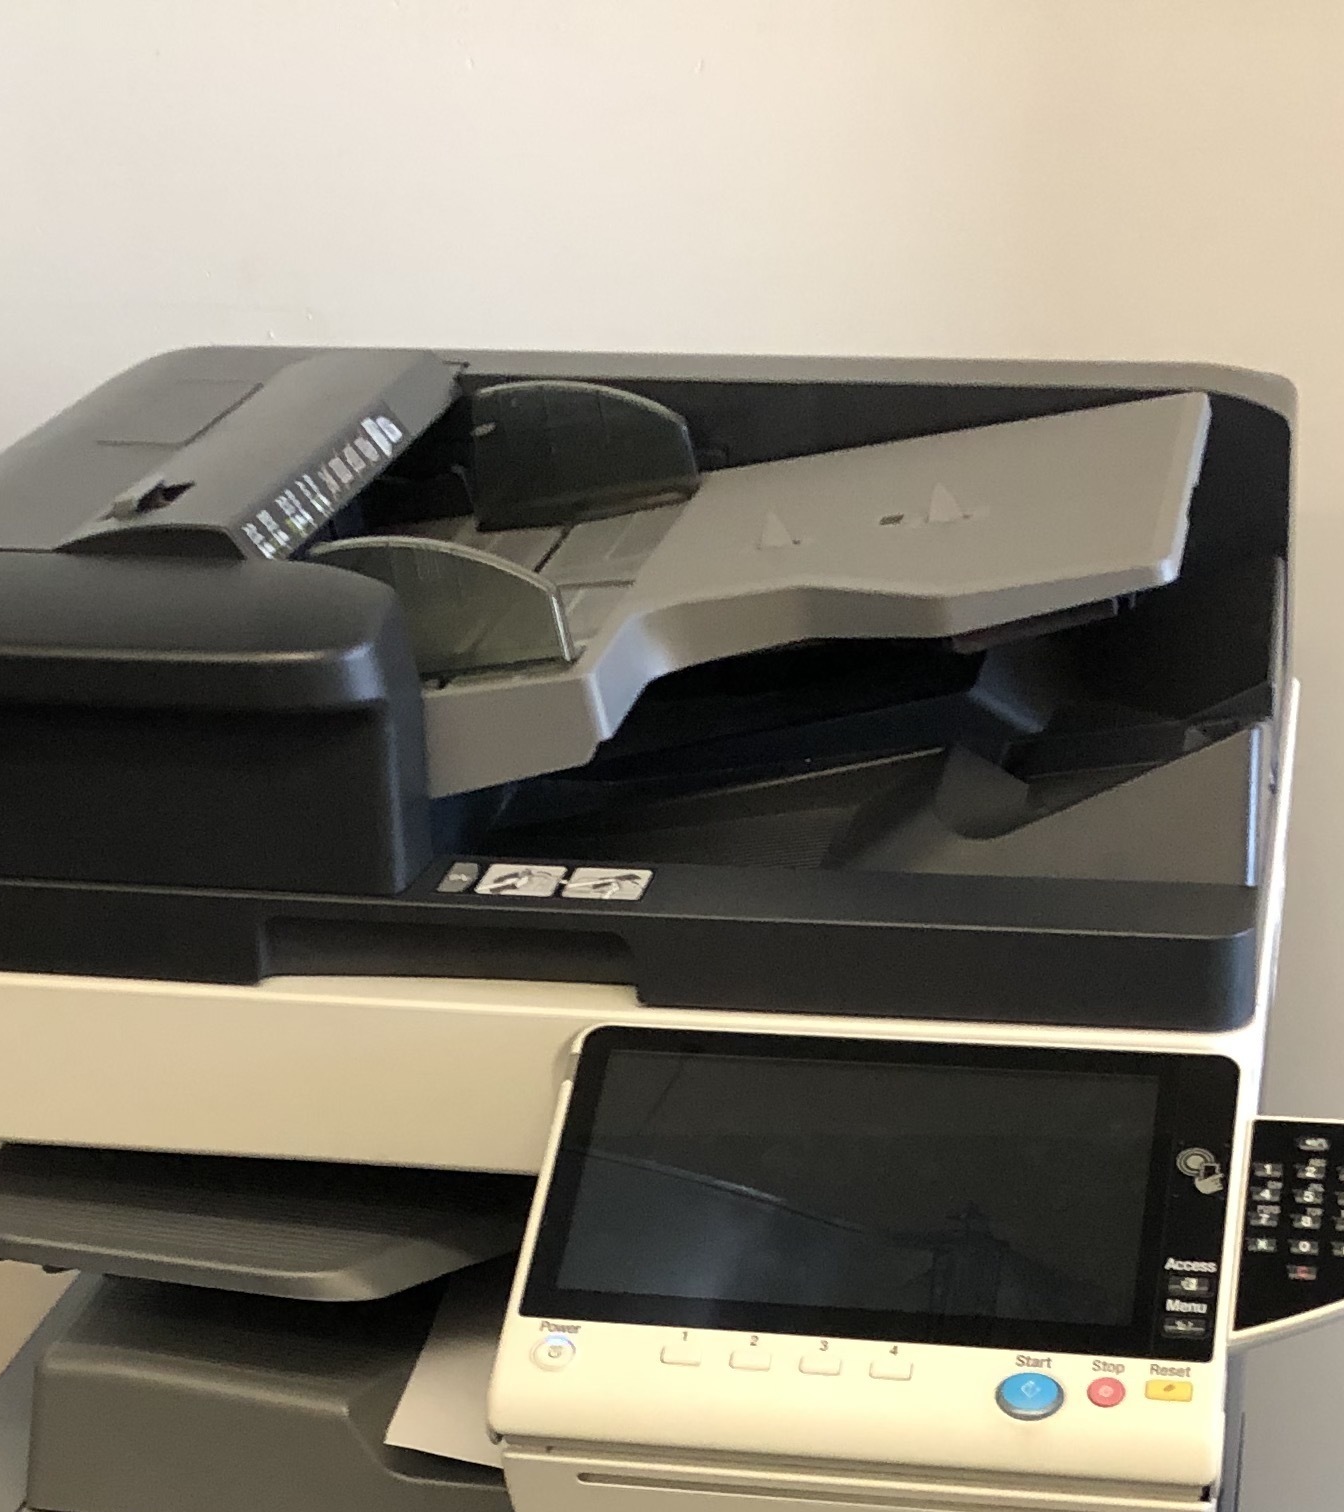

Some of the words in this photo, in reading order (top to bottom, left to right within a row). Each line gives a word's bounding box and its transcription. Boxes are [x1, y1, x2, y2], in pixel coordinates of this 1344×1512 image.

[1164, 1257, 1217, 1273] Access
[1166, 1299, 1208, 1314] Menu
[539, 1320, 582, 1334] Power
[1015, 1354, 1053, 1369] Start
[1092, 1360, 1126, 1375] Stop
[1149, 1363, 1192, 1378] Reset
